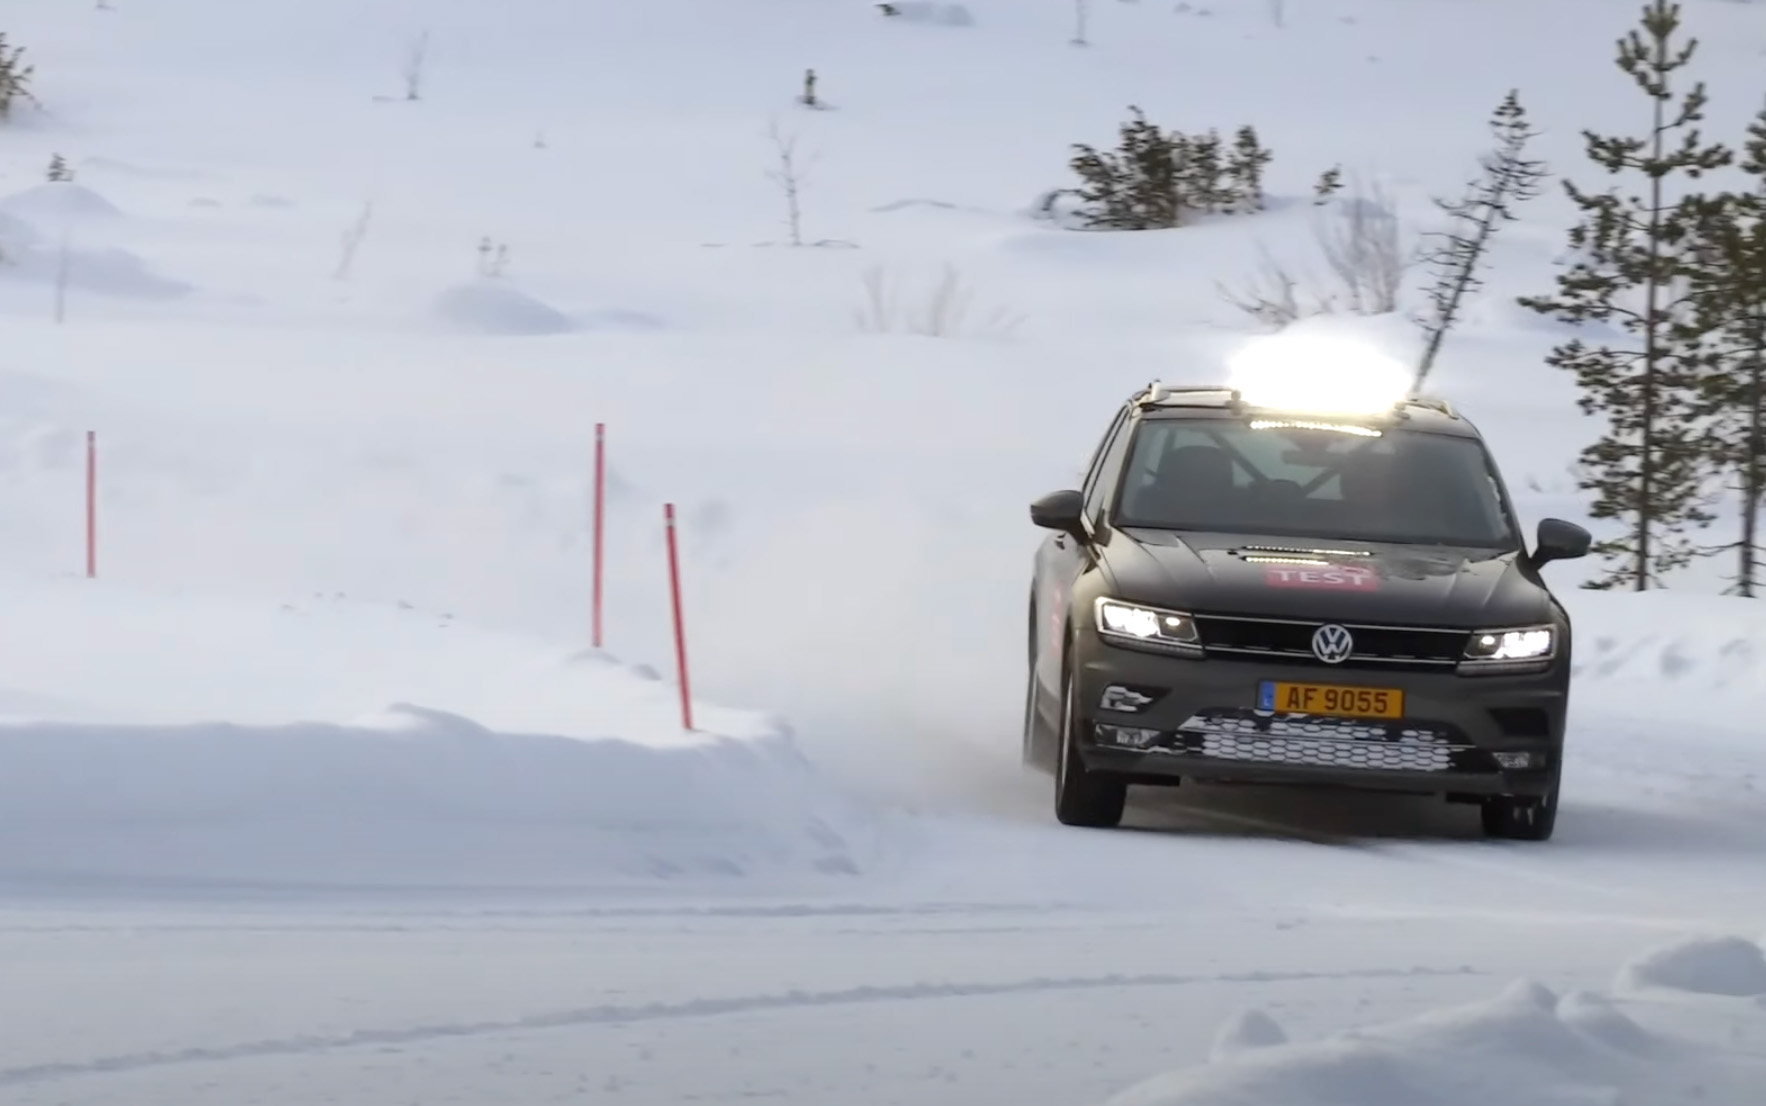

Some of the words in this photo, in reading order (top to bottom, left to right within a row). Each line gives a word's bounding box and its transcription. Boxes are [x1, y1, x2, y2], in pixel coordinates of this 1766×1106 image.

[1269, 569, 1371, 586] TEST
[1286, 686, 1318, 709] AF
[1324, 689, 1389, 714] 9055
